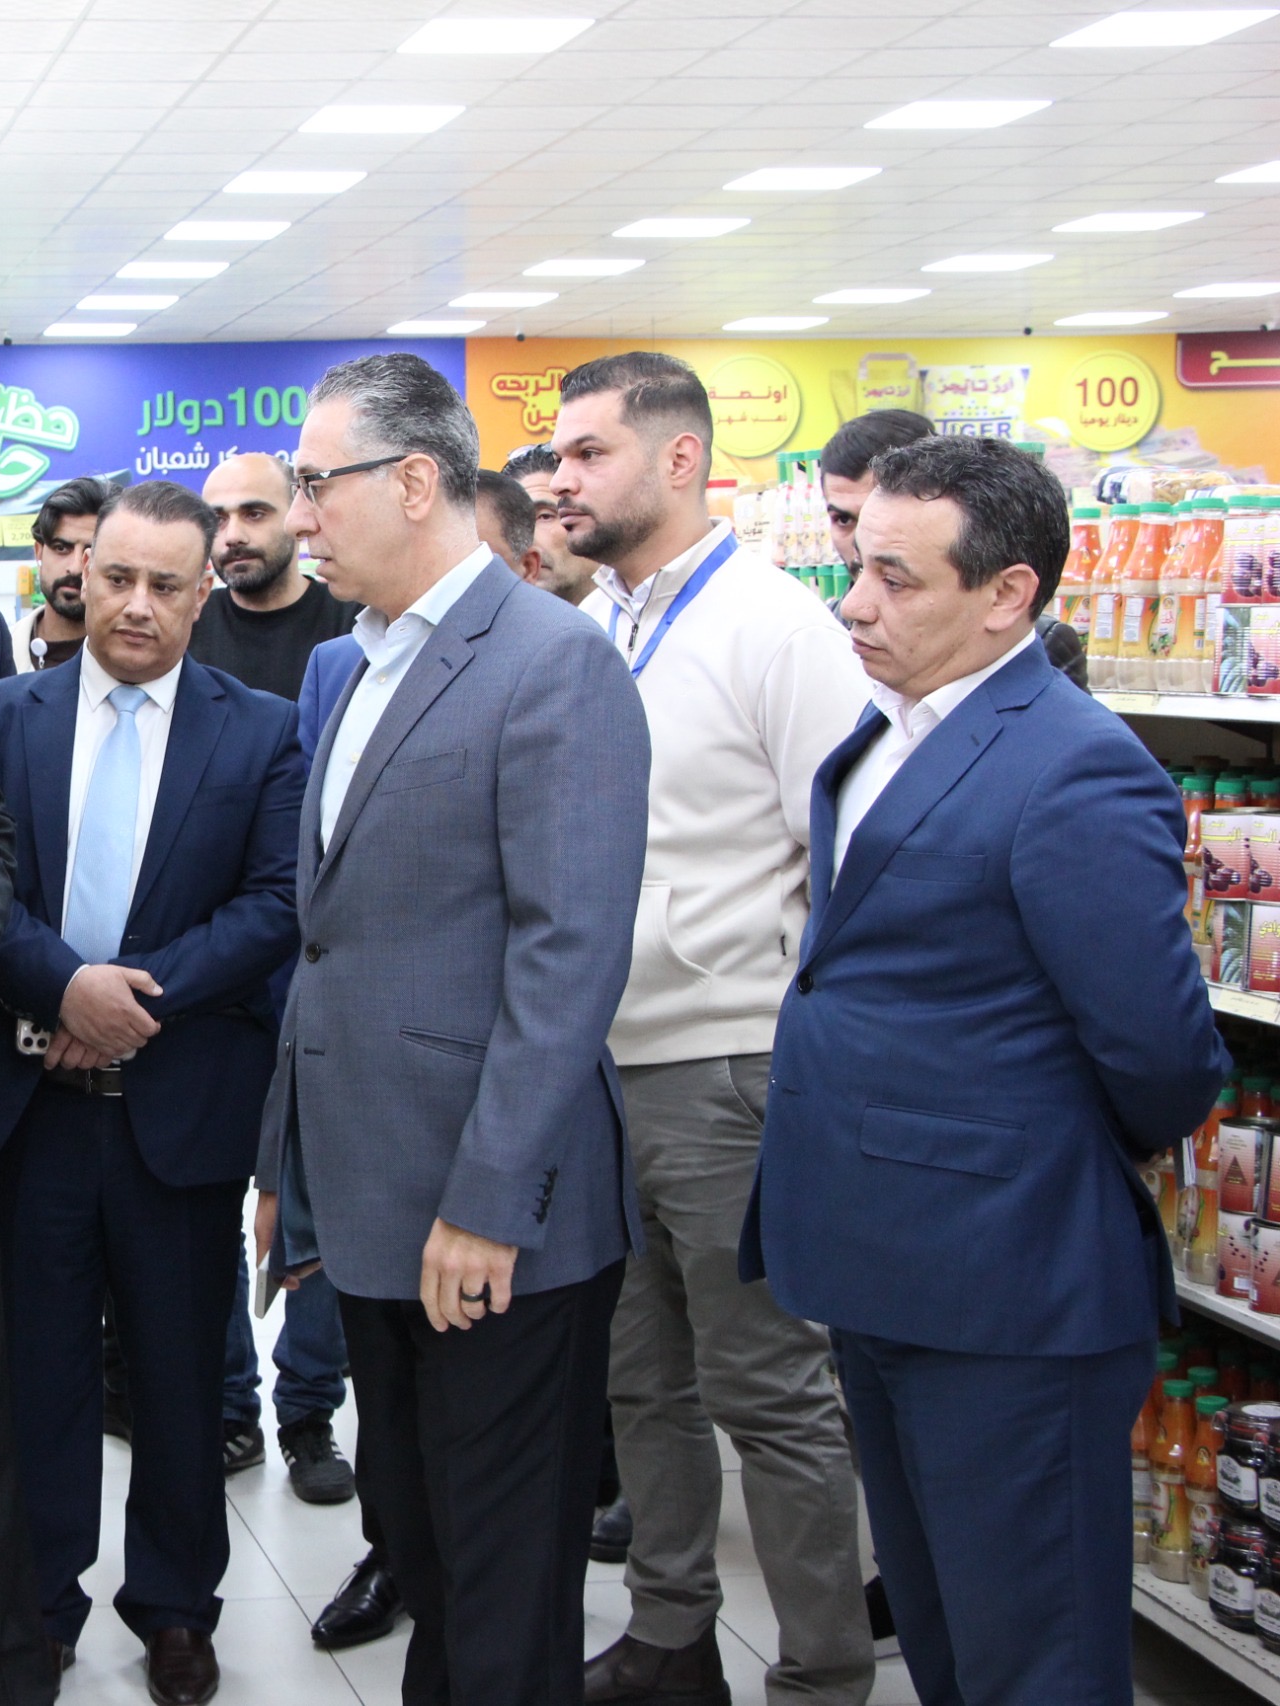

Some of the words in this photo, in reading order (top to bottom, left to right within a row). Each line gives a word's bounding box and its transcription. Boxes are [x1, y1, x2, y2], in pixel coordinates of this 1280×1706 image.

[228, 385, 308, 427] 100
[1075, 376, 1140, 407] 100
[136, 390, 224, 436] دولار
[935, 416, 1013, 439] TIGER
[135, 441, 211, 476] شعبان
[11, 533, 33, 542] 2,70
